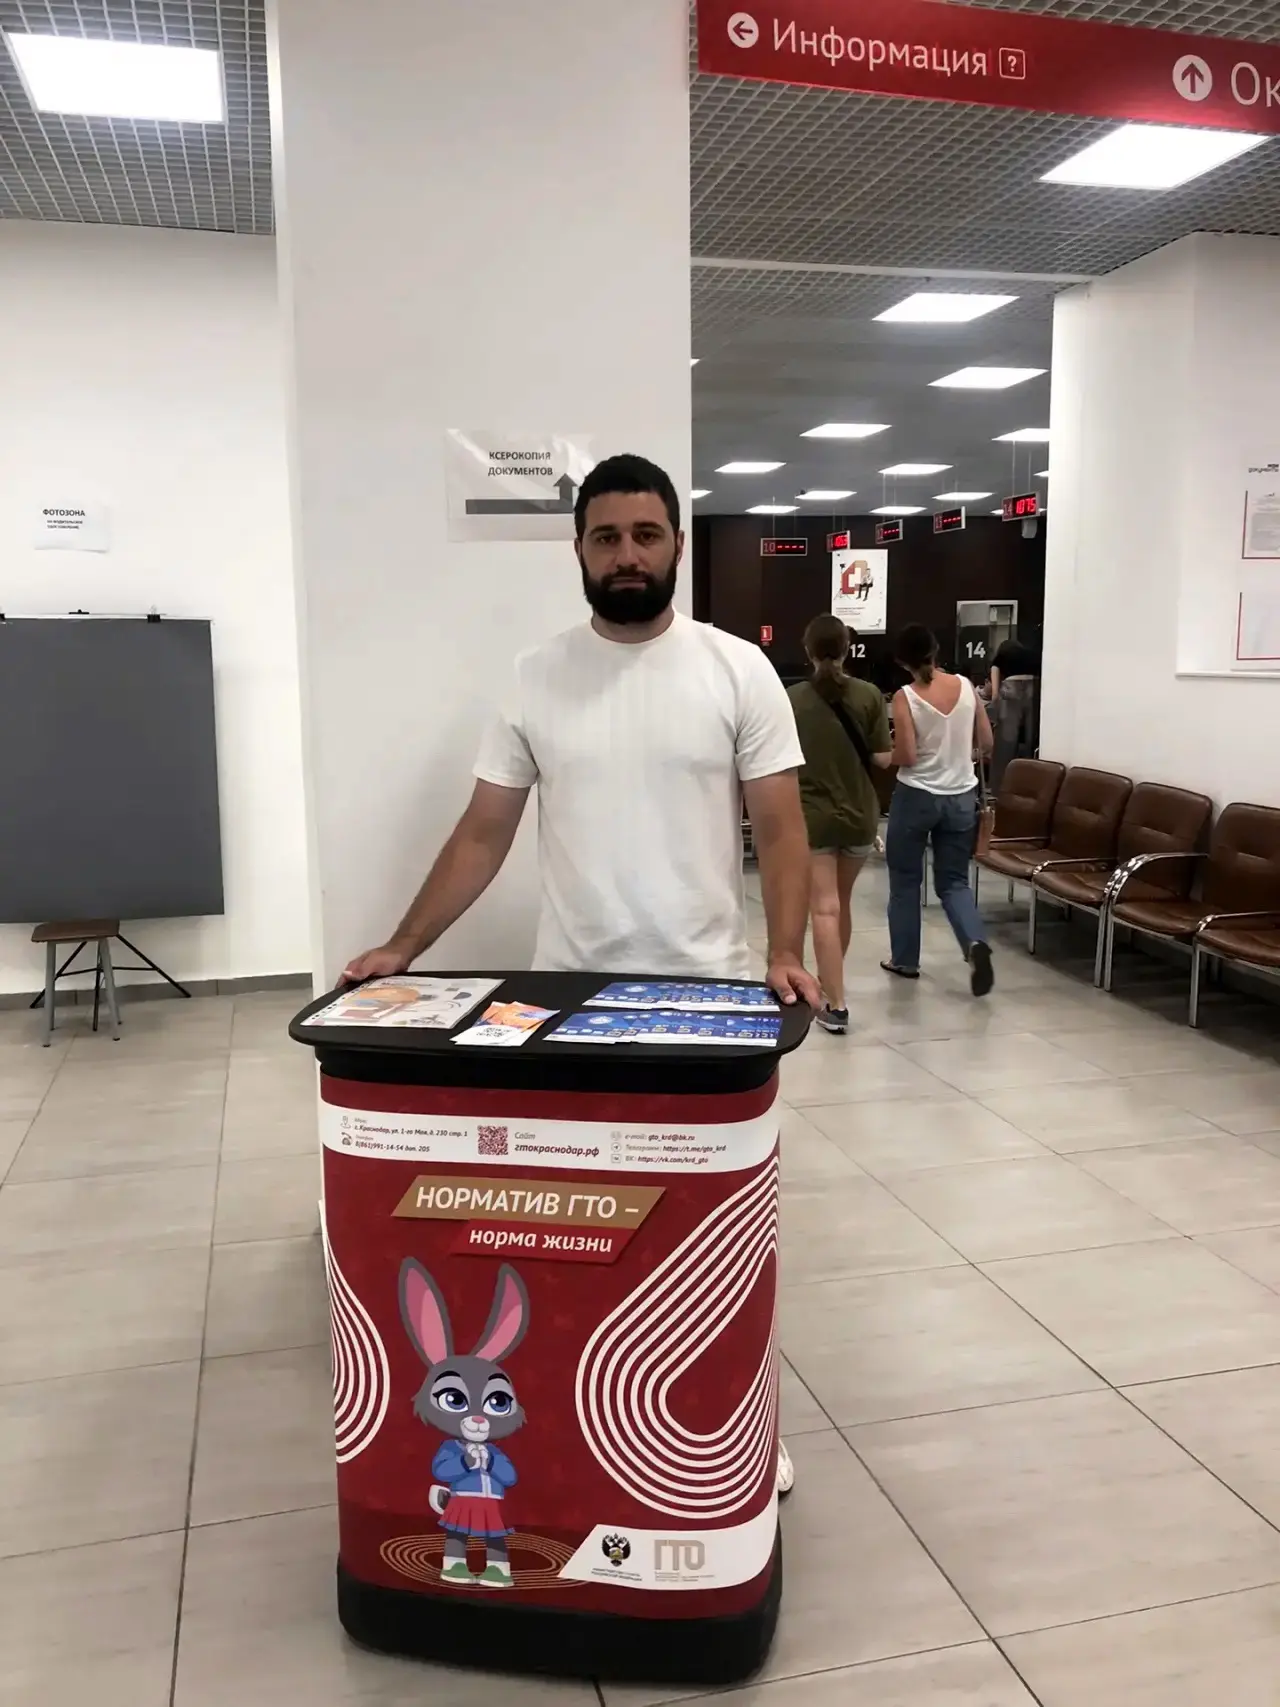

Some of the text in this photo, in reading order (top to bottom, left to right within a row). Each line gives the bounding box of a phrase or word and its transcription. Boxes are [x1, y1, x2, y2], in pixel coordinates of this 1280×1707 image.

[773, 18, 987, 77] Информация
[489, 452, 551, 460] КСЕРОКОПИЯ
[488, 467, 553, 476] ДОКУМЕНТОВ
[763, 542, 775, 552] 10
[850, 643, 866, 658] 12
[966, 642, 986, 658] 14
[514, 1131, 535, 1140] Сайт
[648, 1134, 695, 1143] gto_krd@bk.ru
[514, 1144, 599, 1157] гтокраснодар.рф
[416, 1186, 559, 1215] НОРМАТИВ
[567, 1194, 616, 1218] ГТО
[469, 1230, 612, 1252] норма жизни
[655, 1540, 705, 1571] ГТО
